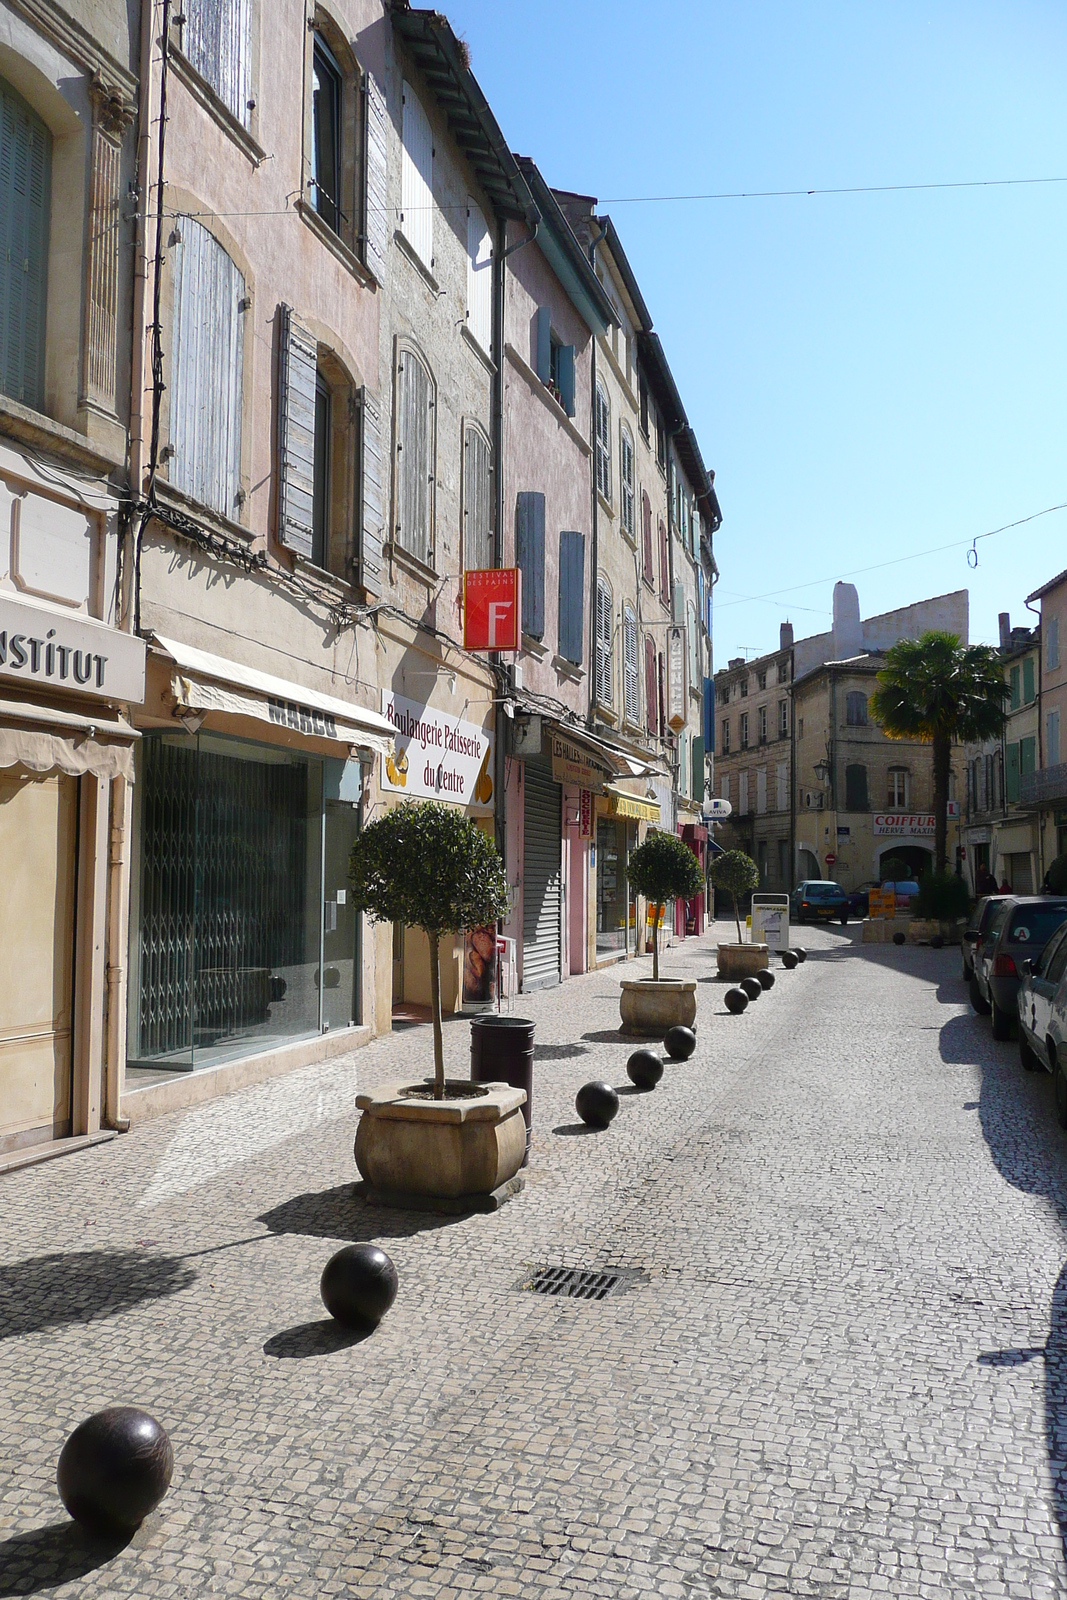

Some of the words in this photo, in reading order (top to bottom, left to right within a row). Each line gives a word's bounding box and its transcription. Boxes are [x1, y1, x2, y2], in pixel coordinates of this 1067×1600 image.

[467, 571, 514, 579] FESTIVAL
[488, 601, 513, 647] F
[387, 703, 443, 750] Boulangerie
[562, 742, 581, 764] HALLES
[423, 760, 435, 788] du
[437, 763, 465, 794] Centre
[1018, 928, 1027, 939] A
